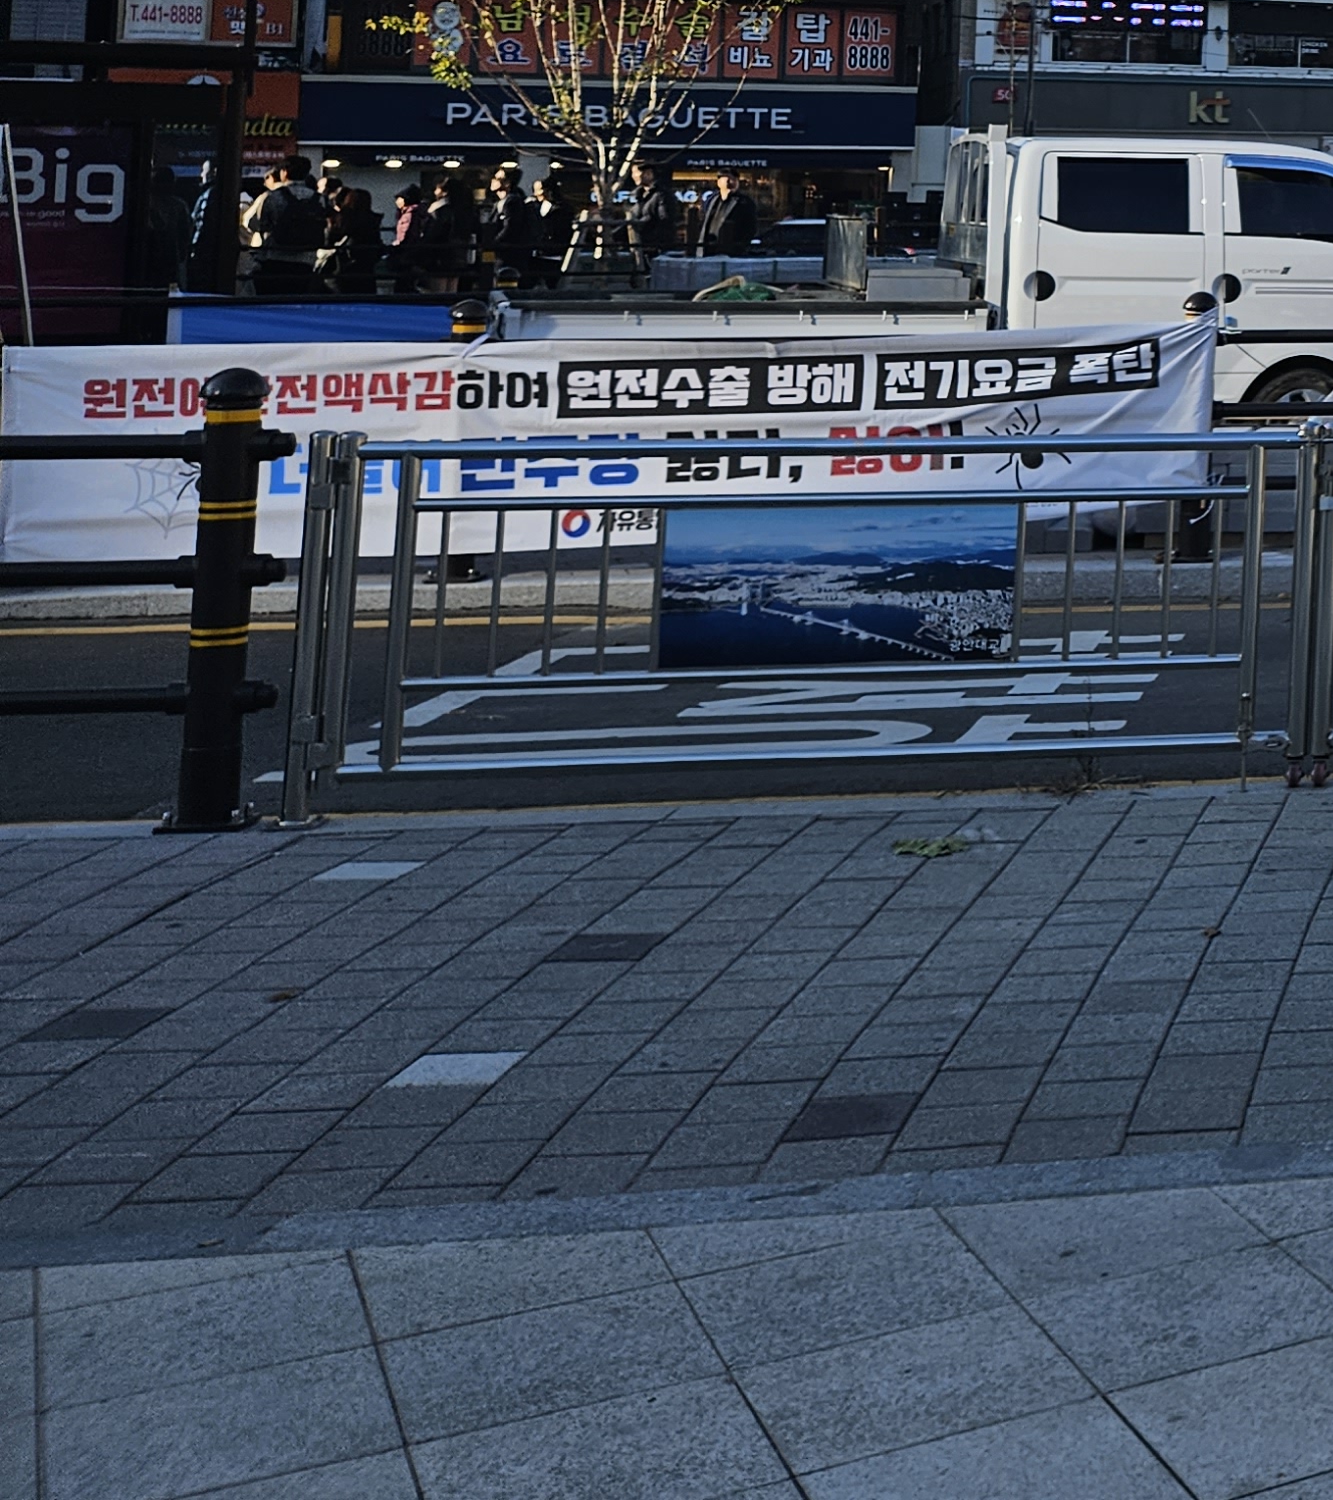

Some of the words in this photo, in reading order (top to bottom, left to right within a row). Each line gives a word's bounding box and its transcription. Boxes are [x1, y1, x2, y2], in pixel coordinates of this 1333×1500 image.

[130, 4, 203, 25] T.441-8888
[846, 16, 891, 43] 441-
[847, 44, 891, 70] 8888
[584, 103, 793, 131] BAGUETTE
[1188, 90, 1232, 124] kt
[566, 363, 751, 410] 원전수출
[766, 362, 855, 405] 방해
[883, 353, 1057, 402] 전기요금
[1069, 342, 1154, 385] 폭탄
